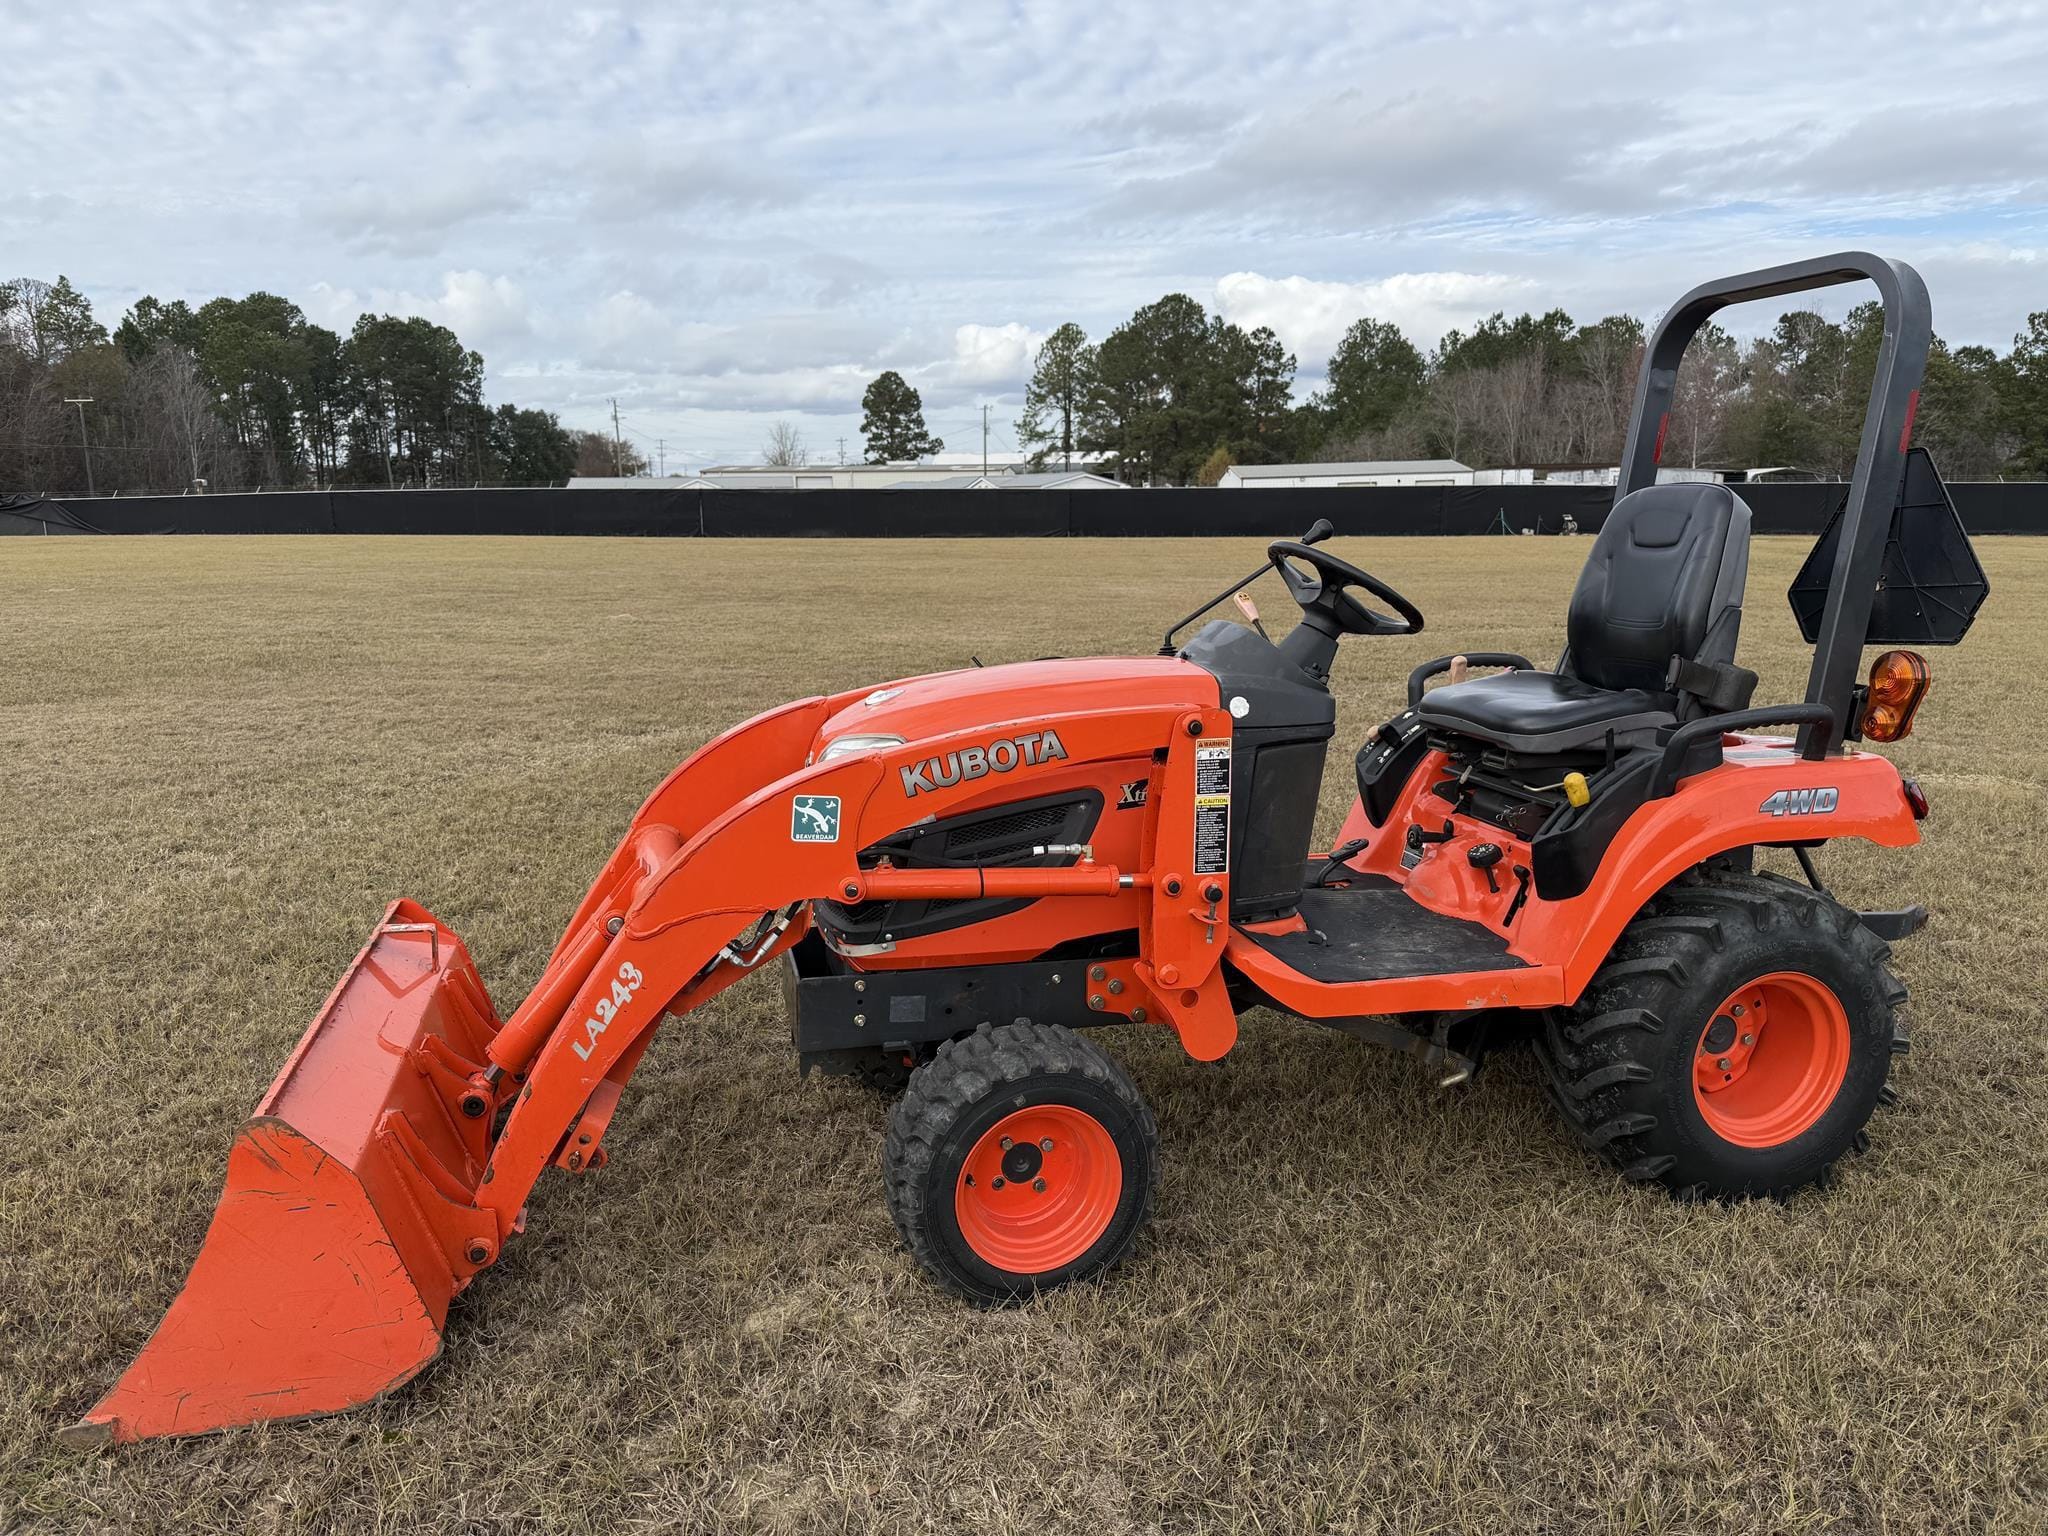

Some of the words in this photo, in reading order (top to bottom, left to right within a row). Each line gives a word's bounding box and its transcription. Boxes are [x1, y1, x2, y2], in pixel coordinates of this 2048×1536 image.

[899, 729, 1068, 798] KUBOTA
[1759, 786, 1839, 817] 4WD
[571, 961, 643, 1062] LA243
